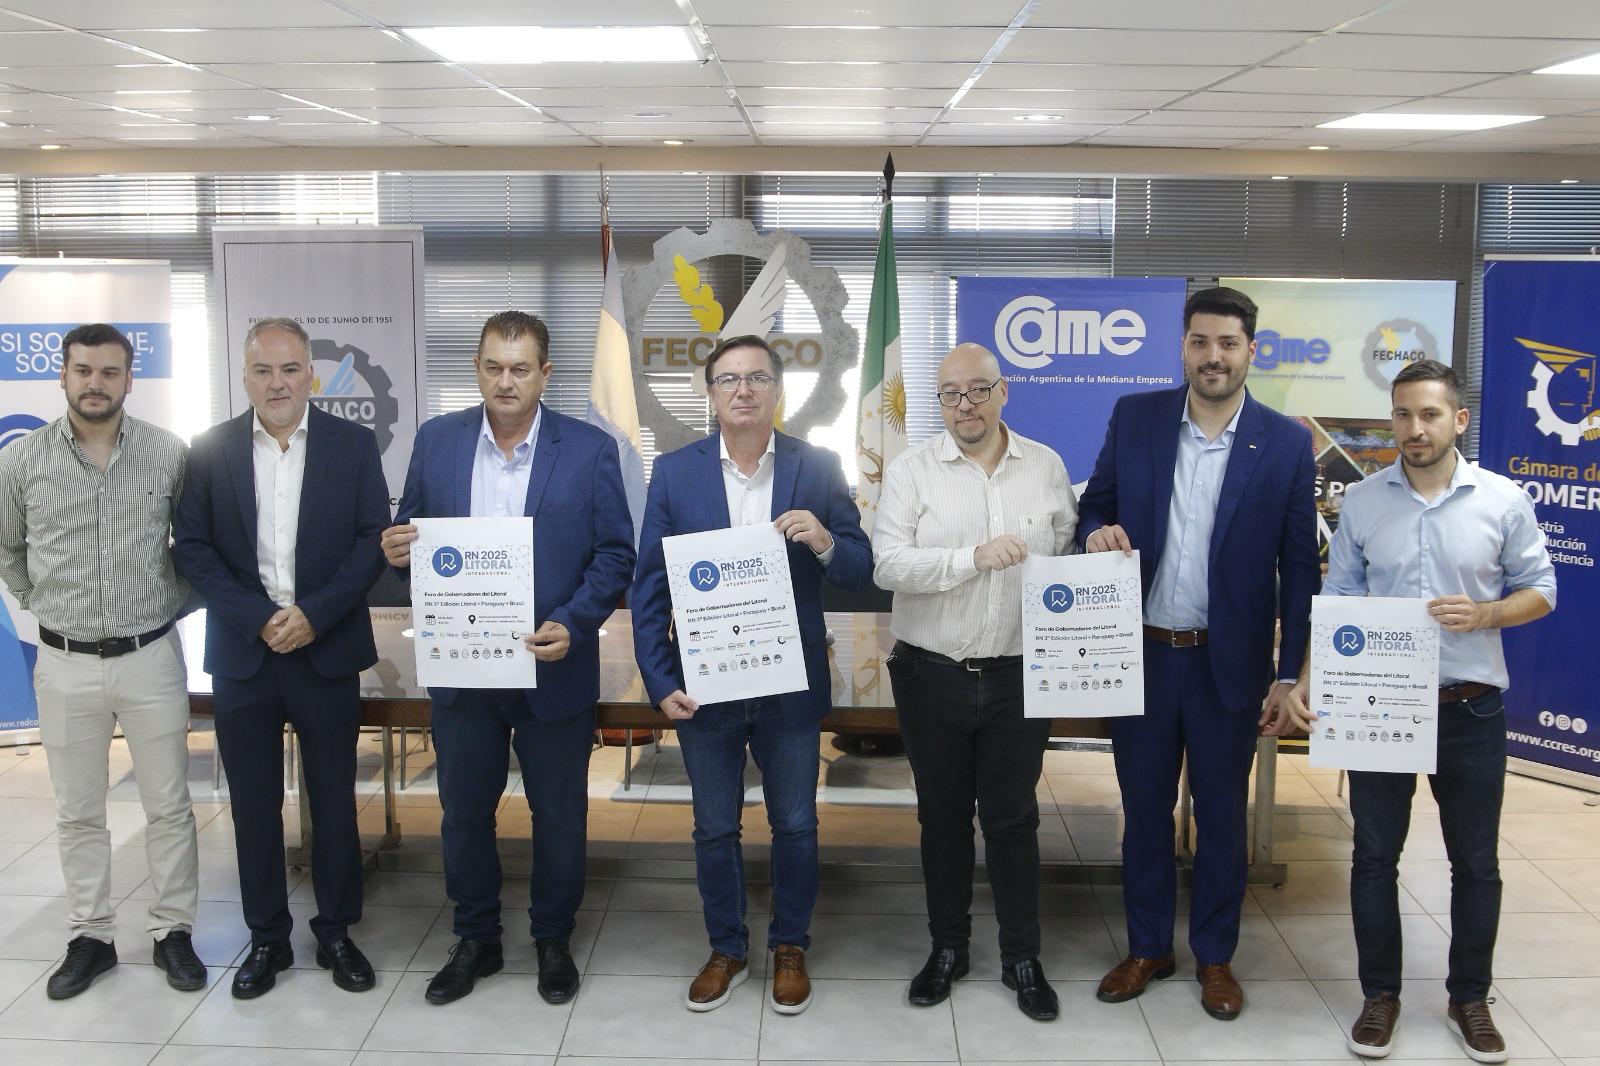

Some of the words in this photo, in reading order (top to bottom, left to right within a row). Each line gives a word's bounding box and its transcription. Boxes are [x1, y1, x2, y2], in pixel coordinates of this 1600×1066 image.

[1, 332, 21, 352] SI
[29, 332, 67, 352] SO
[642, 337, 822, 367] FECCO
[1372, 350, 1426, 361] FECHACO
[1029, 375, 1072, 384] Argentina
[1074, 375, 1085, 383] de
[1087, 375, 1095, 383] la
[1097, 376, 1134, 384] Mediana
[1136, 376, 1173, 385] Empresa
[1508, 456, 1578, 480] Cámara
[464, 551, 479, 560] RN
[480, 550, 508, 560] 2025
[464, 560, 513, 570] LITORAL
[720, 563, 735, 572] RN
[736, 558, 763, 570] 2025
[721, 567, 769, 581] LITORAL
[1075, 588, 1090, 596] RN
[1091, 584, 1116, 595] 2025
[1076, 593, 1122, 605] LITORAL
[1367, 631, 1382, 640] RN
[1384, 631, 1412, 641] 2025
[1367, 640, 1418, 652] LITORAL
